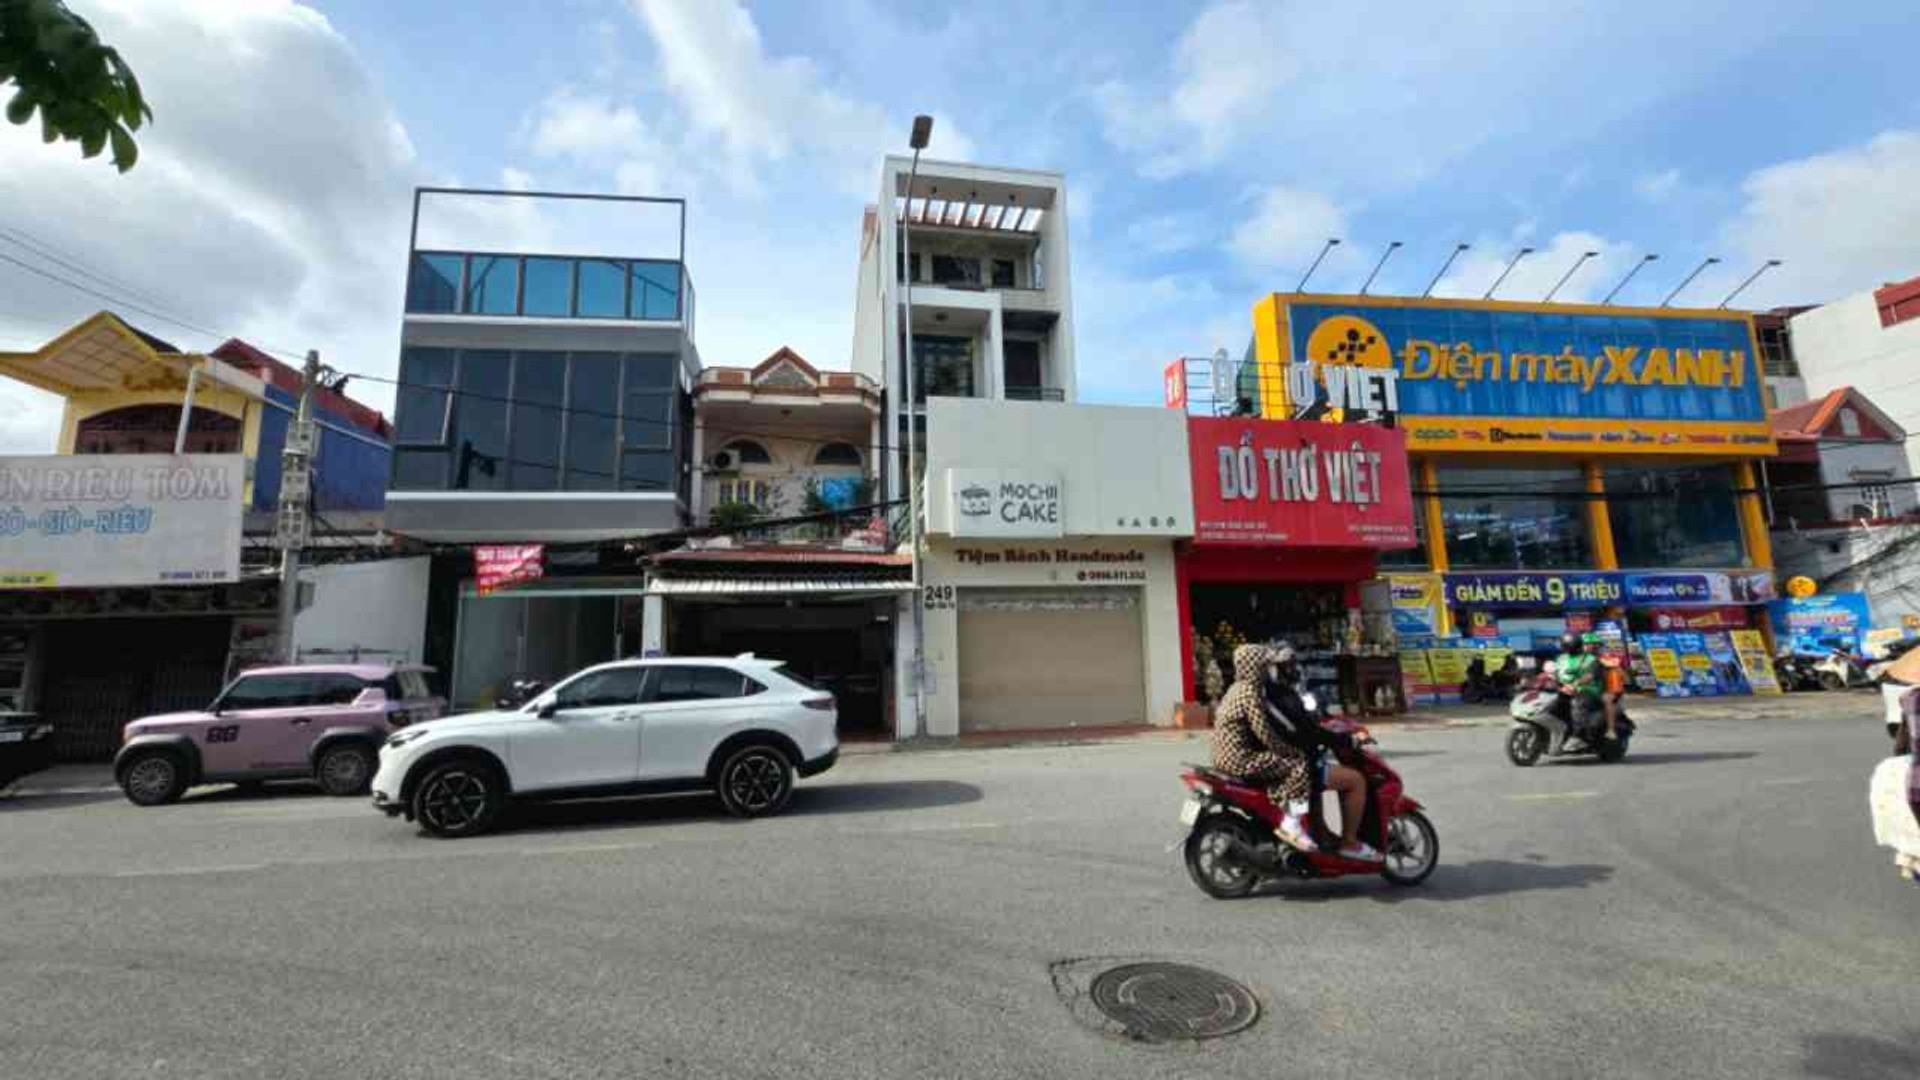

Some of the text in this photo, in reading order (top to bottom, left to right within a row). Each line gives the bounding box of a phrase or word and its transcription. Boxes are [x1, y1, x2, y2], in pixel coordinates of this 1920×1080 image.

[1398, 340, 1501, 390] Điện
[1322, 440, 1382, 511] VIỆT
[1000, 501, 1057, 523] CAKE
[956, 549, 1000, 565] Tiệm
[1056, 548, 1145, 563] Handmade
[925, 585, 953, 601] 249
[1456, 577, 1500, 602] GIẢM
[1546, 578, 1566, 604] 9
[1568, 579, 1621, 605] TRIỆU
